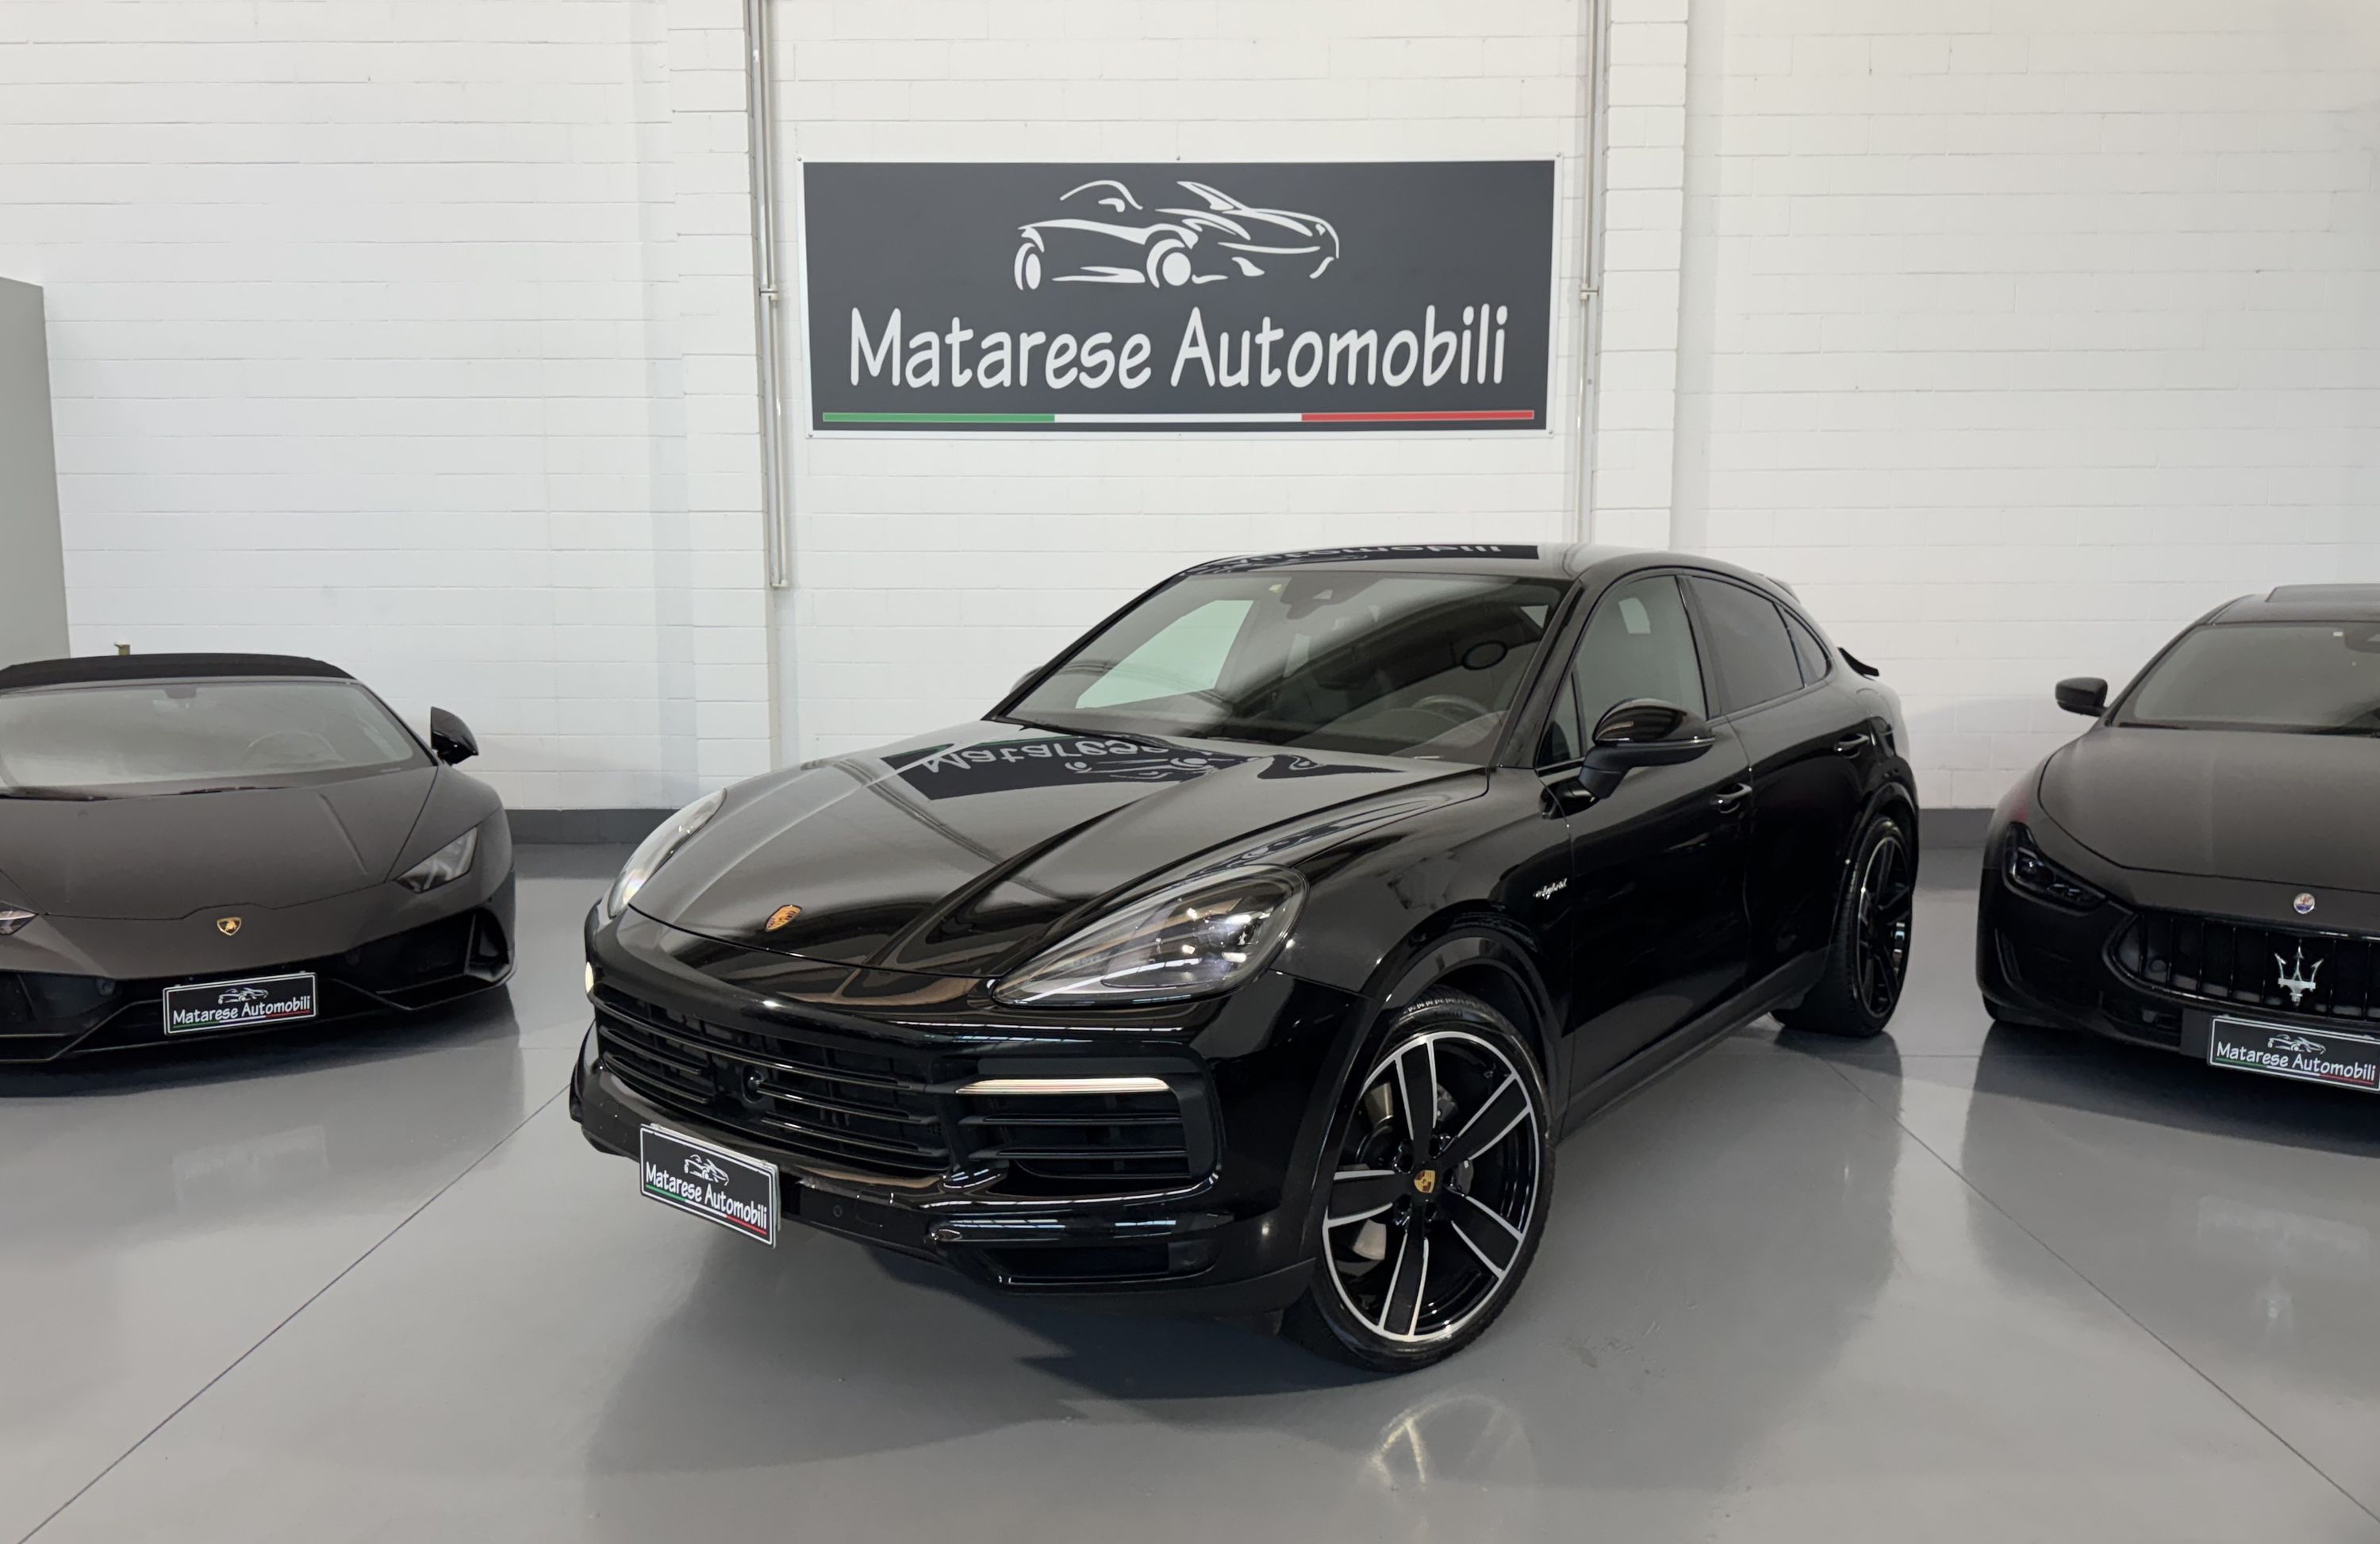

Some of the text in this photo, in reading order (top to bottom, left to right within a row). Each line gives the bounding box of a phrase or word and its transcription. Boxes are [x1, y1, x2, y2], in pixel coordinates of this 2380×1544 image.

[850, 303, 1509, 390] Matarese Automobili
[173, 996, 311, 1024] Matarese Automobili
[2217, 1041, 2376, 1081] Matarese Automobili
[646, 1161, 767, 1230] Matarese Automobili
